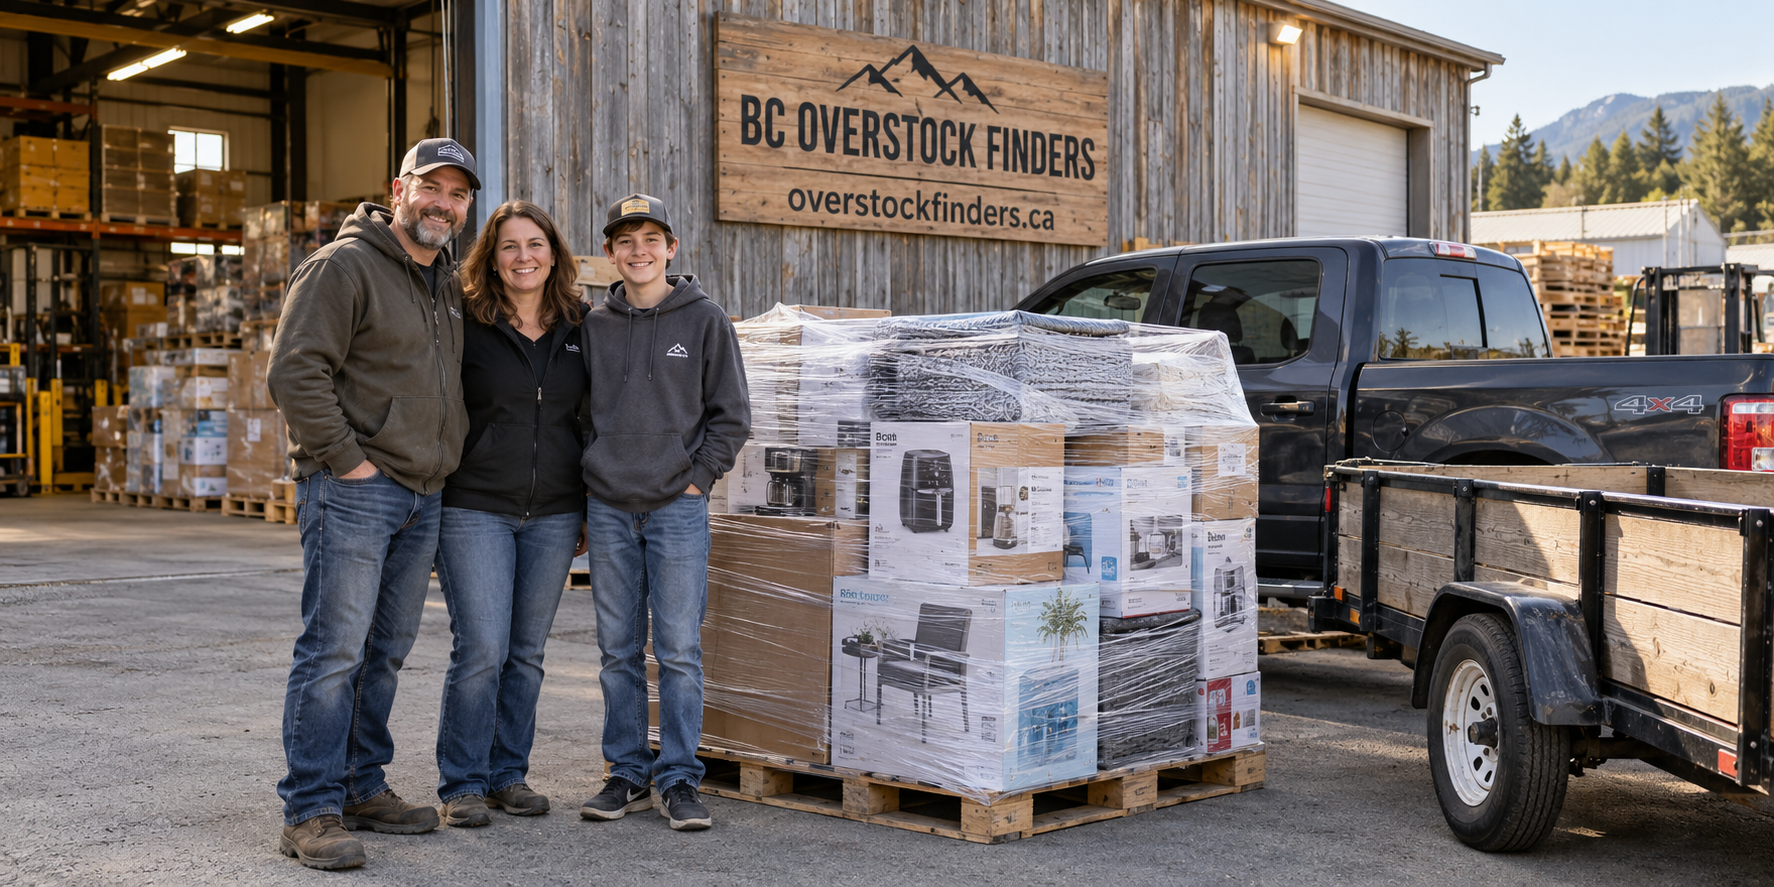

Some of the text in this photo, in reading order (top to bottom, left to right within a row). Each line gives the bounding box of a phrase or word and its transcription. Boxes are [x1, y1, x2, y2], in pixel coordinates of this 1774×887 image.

[741, 94, 1095, 180] BC OVERSTOCK FINDERS
[787, 187, 1055, 231] overstockfinders.ca
[1614, 394, 1704, 415] 4x4
